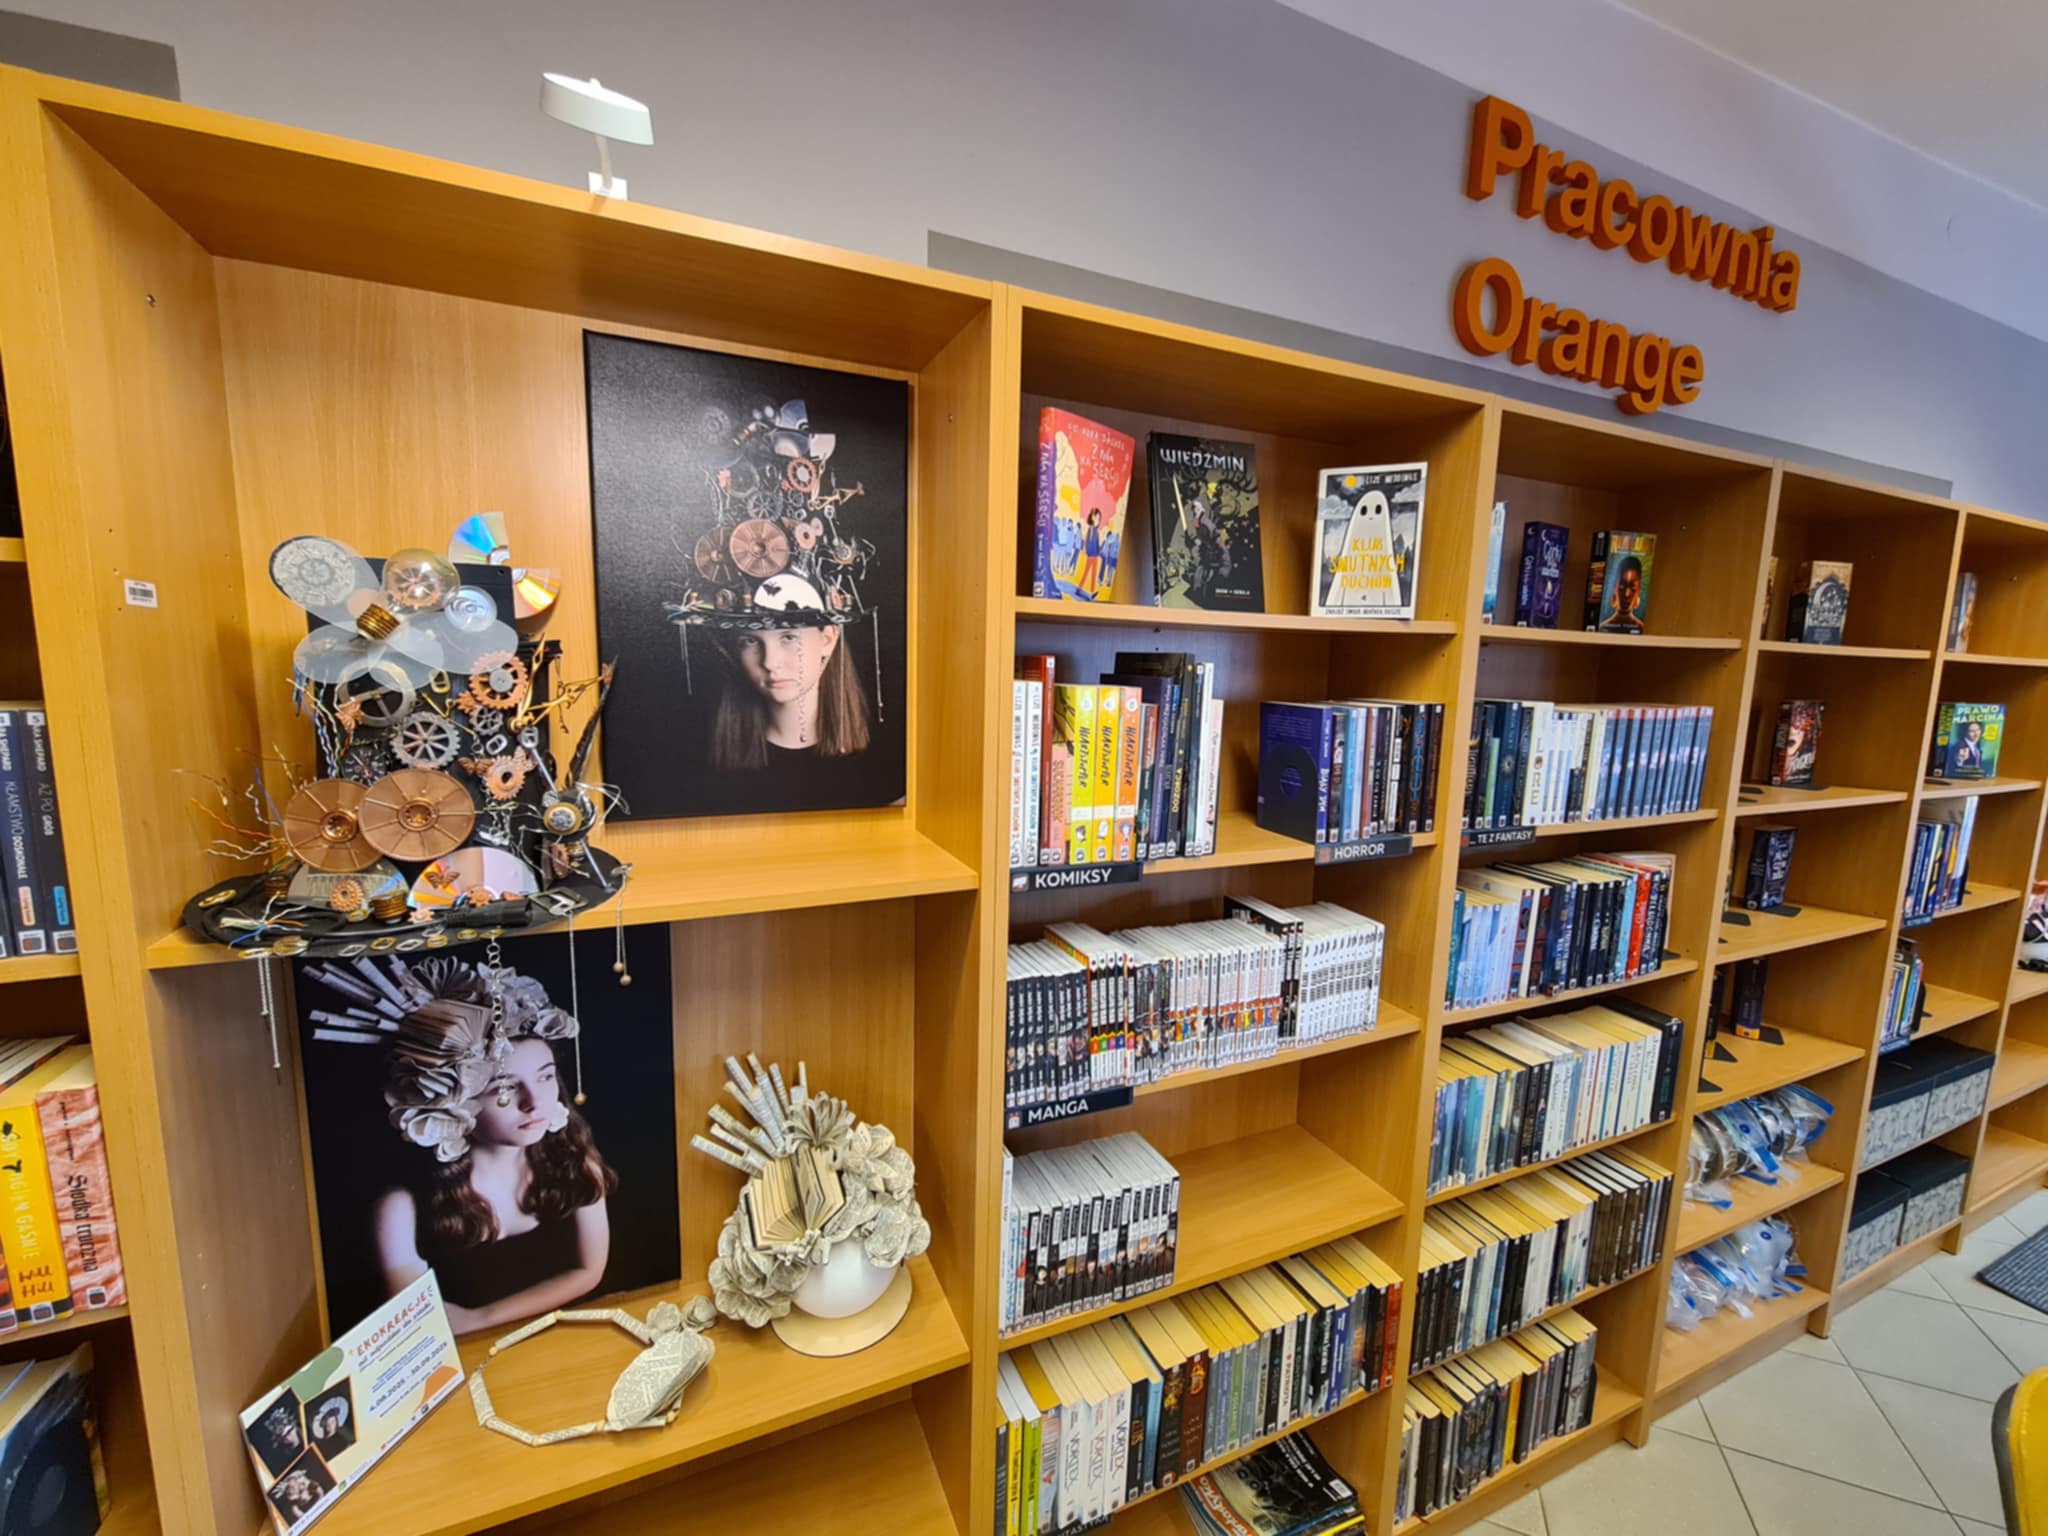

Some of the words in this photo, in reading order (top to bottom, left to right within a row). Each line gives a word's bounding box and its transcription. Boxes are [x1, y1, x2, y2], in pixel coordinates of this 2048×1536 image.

[1466, 95, 1801, 314] Pracownia
[1453, 257, 1704, 416] Orange
[1351, 537, 1384, 552] KLUB
[1328, 553, 1407, 574] SMUTNYCH
[1957, 704, 1999, 715] PRAWO
[5, 781, 25, 837] KŁAMSTWO
[1478, 834, 1489, 844] TE
[1490, 833, 1495, 843] Z
[1495, 831, 1532, 842] FANTASY
[1334, 843, 1385, 859] HORROR
[1035, 868, 1112, 888] KOMIKSY
[1028, 1099, 1089, 1123] MANGA
[22, 1281, 54, 1299] Hill
[357, 1292, 427, 1357] EKOKREACJE
[1112, 1420, 1128, 1475] VORTEX
